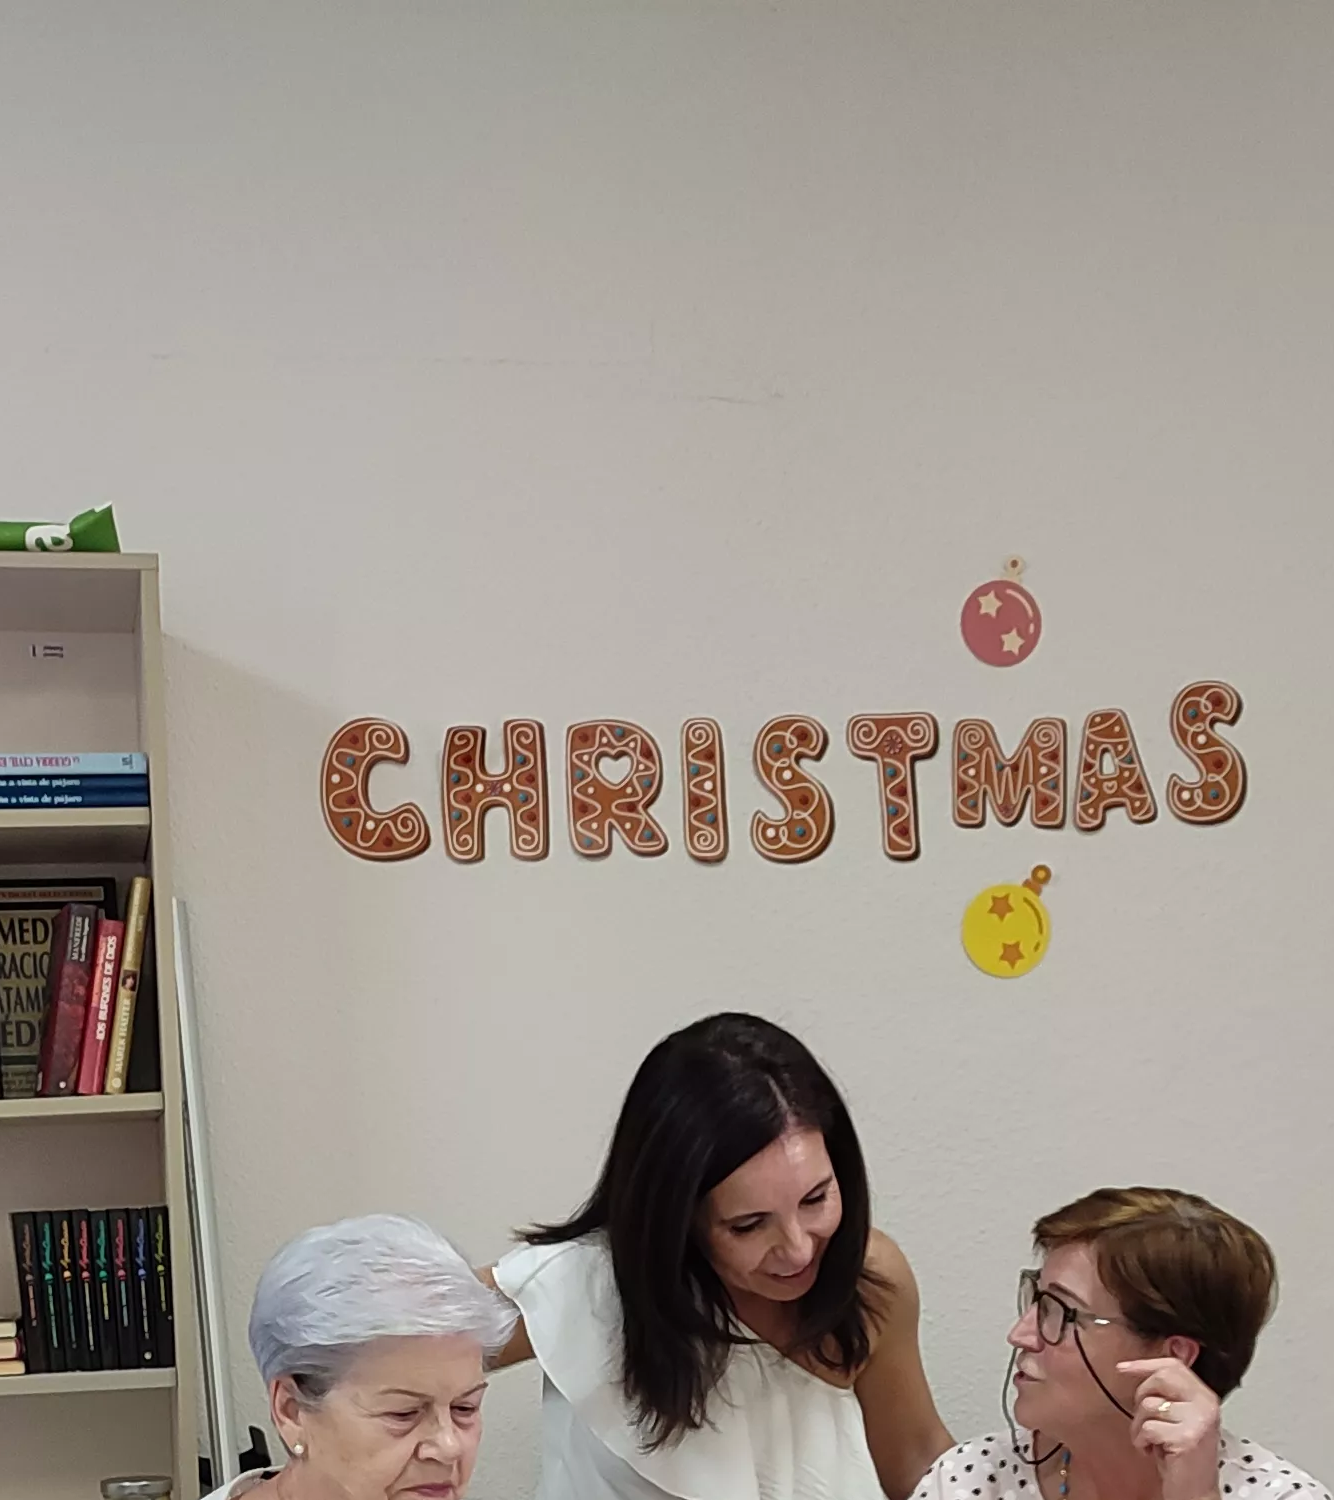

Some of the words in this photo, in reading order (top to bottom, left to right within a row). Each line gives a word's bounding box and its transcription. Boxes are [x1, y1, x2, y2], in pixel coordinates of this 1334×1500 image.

[8, 756, 34, 766] CIVIL
[320, 679, 1248, 865] CHRISTMAS
[105, 935, 117, 960] DIOS
[103, 961, 115, 976] DE
[97, 976, 113, 1021] BUFONES
[95, 1022, 108, 1041] LOS
